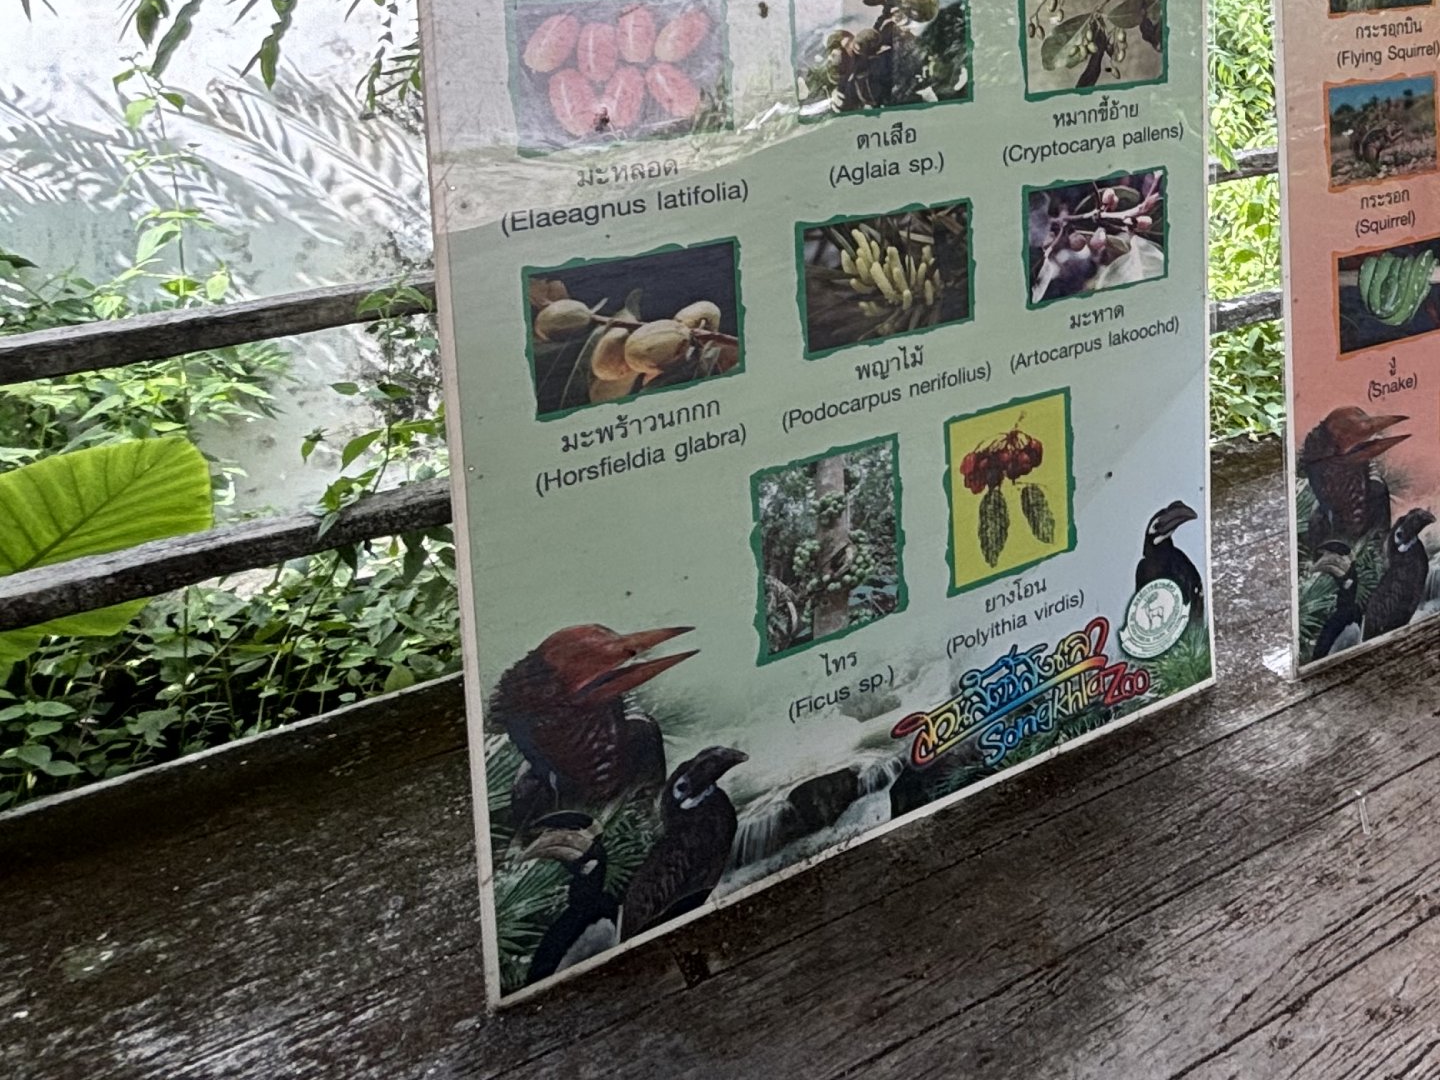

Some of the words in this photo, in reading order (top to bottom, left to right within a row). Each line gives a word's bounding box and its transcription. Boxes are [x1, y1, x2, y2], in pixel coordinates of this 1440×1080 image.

[1337, 48, 1382, 68] (Flying
[1387, 40, 1440, 62] Squirrel)
[1053, 96, 1139, 129] หมากขี้อ้าย
[857, 121, 917, 151] ตาเสือ
[1002, 132, 1115, 167] (Cryptocarya
[1122, 123, 1185, 153] pallens)
[577, 157, 679, 188] มะหลอด
[829, 162, 901, 188] (Aglaia
[908, 152, 945, 178] sp.)
[501, 196, 646, 237] (Elaeagnus
[657, 180, 749, 212] latifolia)
[1360, 188, 1410, 210] กระรอก
[1355, 210, 1416, 238] (Squirrel)
[1069, 304, 1125, 330] มะหาด
[856, 346, 925, 383] พญาไม้
[1010, 339, 1102, 374] (Artocarpus
[781, 385, 902, 433] (Podocarpus
[909, 362, 991, 402] nerifolius)
[1368, 373, 1418, 401] (Snake)
[561, 399, 720, 453] มะพร้าวนกกก
[535, 445, 666, 497] (Horsfieldia
[674, 422, 747, 462] glabra)
[985, 578, 1047, 613] ยางโอน
[1034, 589, 1085, 621] virdis)
[819, 650, 858, 677] ไทร
[788, 684, 850, 724] (Ficus
[858, 665, 896, 697] sp.)
[978, 671, 1107, 766] Songkhla
[1103, 662, 1150, 705] Zoo
